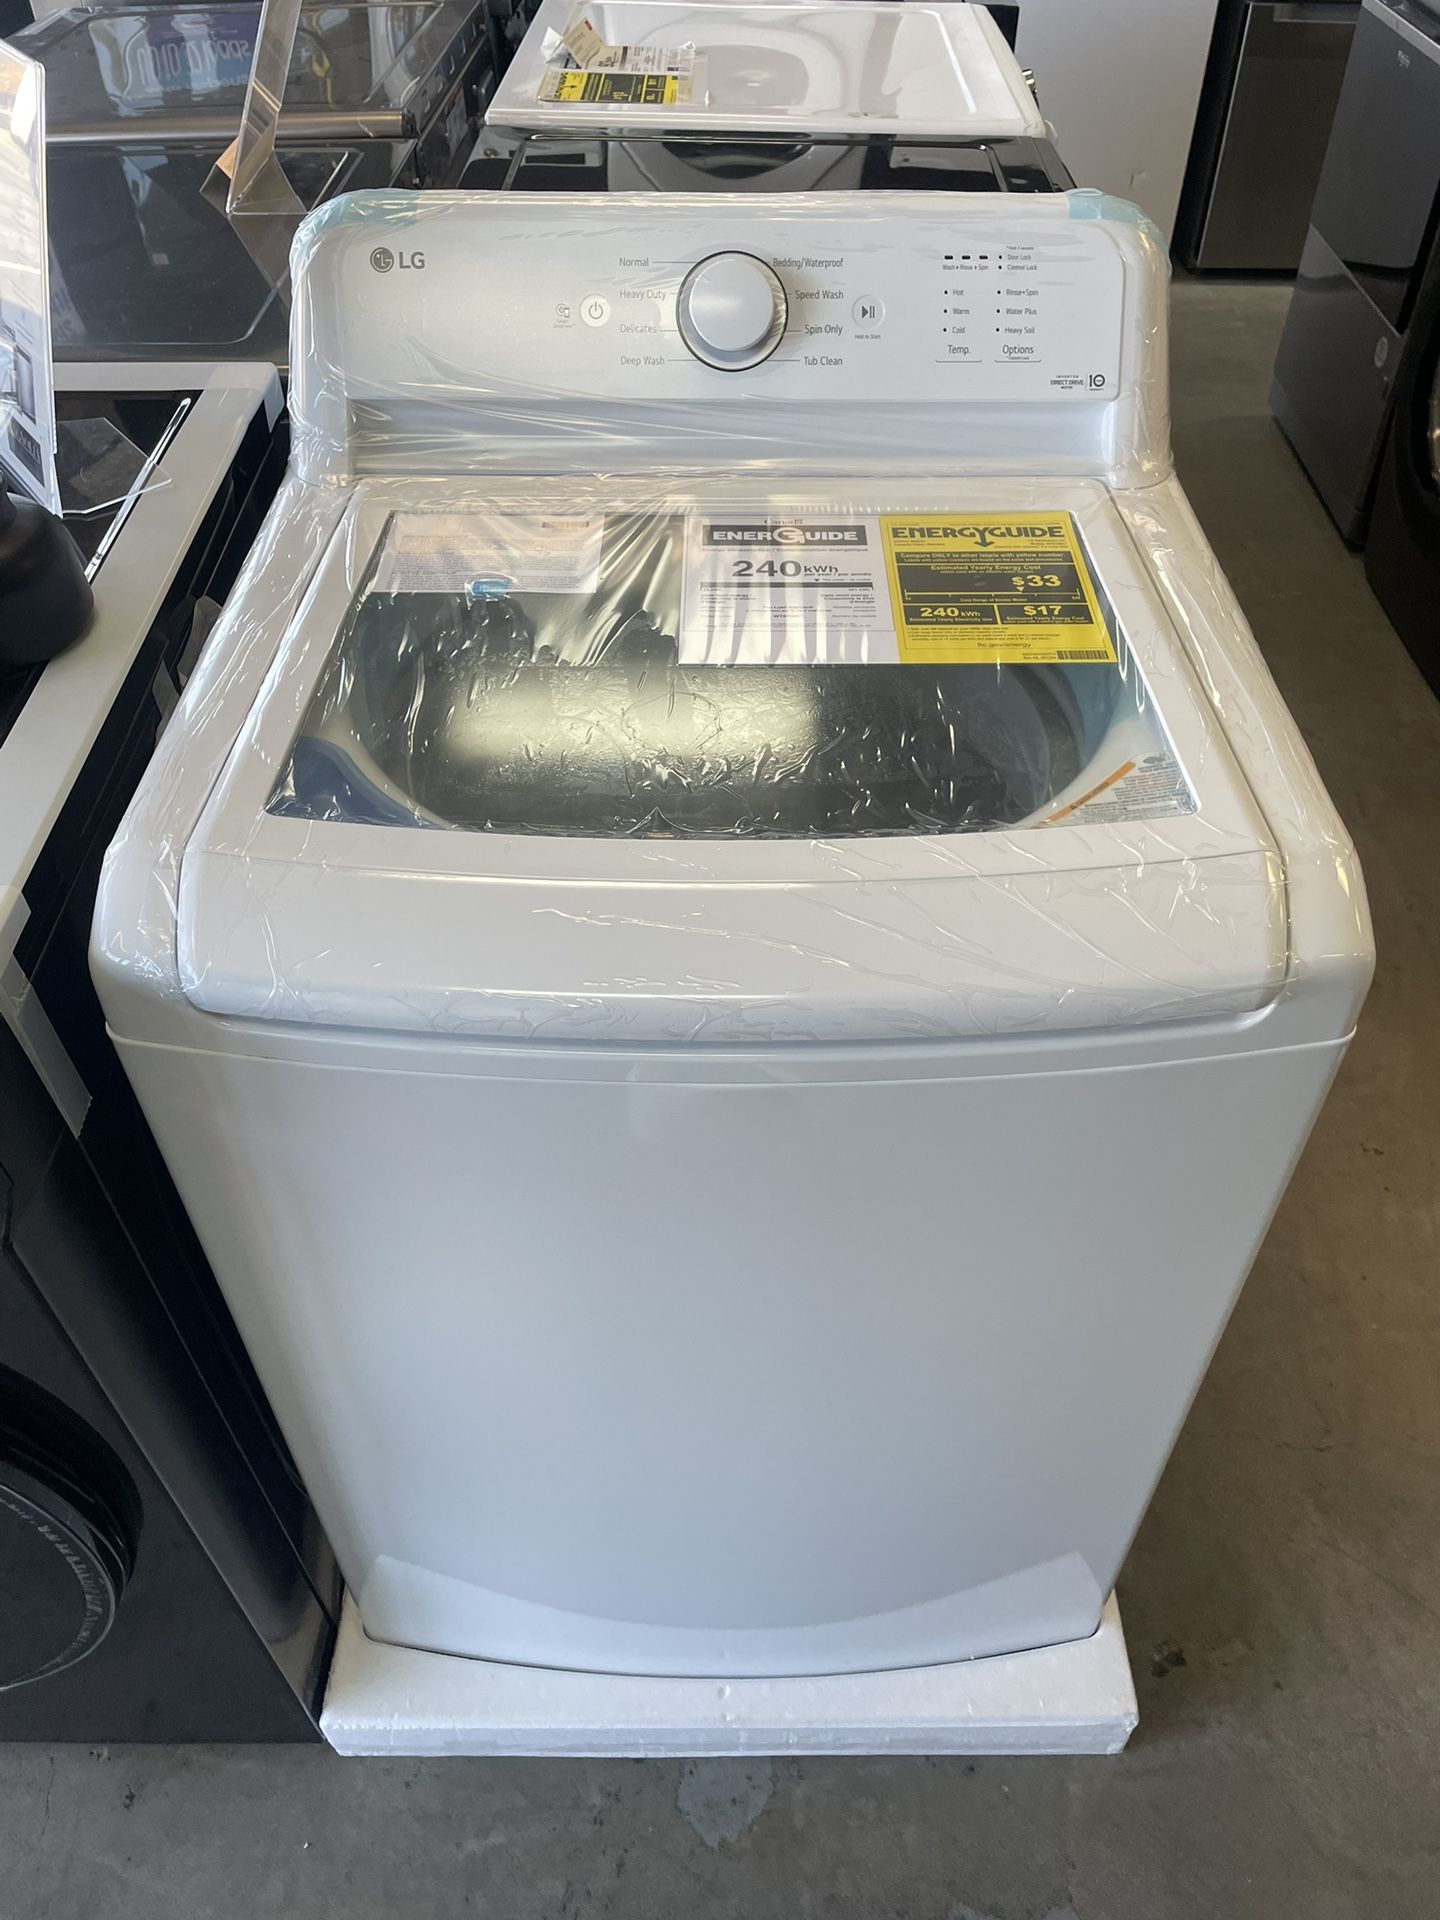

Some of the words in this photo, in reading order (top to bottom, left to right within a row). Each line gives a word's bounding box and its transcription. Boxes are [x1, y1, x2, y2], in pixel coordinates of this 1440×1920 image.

[399, 251, 425, 269] LG
[619, 257, 649, 267] Normal
[773, 257, 844, 270] Bedding/Waterproof
[620, 289, 644, 300] Heavy
[647, 289, 667, 300] Duty
[795, 290, 820, 301] Speed
[822, 290, 844, 299] Wash
[1006, 289, 1039, 297] Rinse+Spin
[620, 324, 657, 333] Delicates
[804, 324, 822, 335] Spin
[824, 324, 843, 335] Only
[1005, 327, 1022, 335] Heavy
[948, 345, 971, 356] Temp.
[1002, 345, 1034, 356] Options
[621, 356, 641, 367] Deep
[644, 356, 665, 366] Wash
[804, 356, 818, 366] Tub
[820, 356, 843, 366] Clean
[892, 527, 1065, 540] ENERGYGUIDE
[732, 559, 801, 577] 240
[804, 565, 838, 573] kWh
[1012, 574, 1061, 587] $33
[920, 607, 959, 617] 240
[1023, 605, 1062, 616] $17
